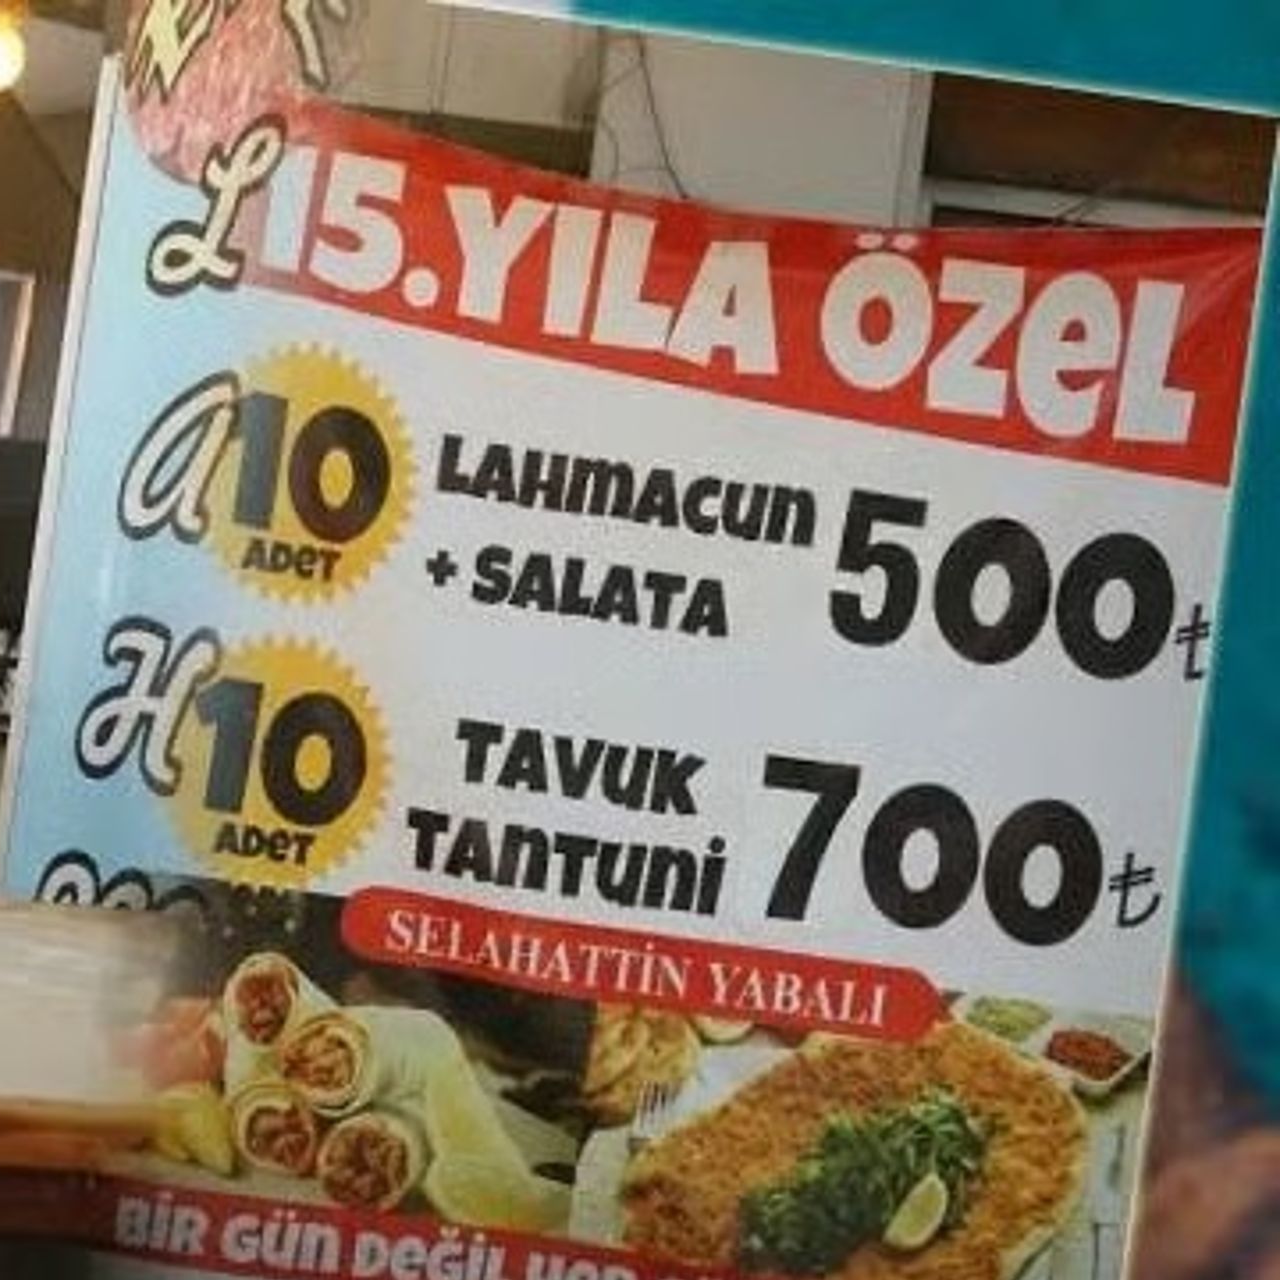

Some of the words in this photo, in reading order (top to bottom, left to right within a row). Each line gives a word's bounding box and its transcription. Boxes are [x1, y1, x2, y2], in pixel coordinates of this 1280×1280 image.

[255, 143, 782, 378] 15.YILA
[819, 233, 1197, 446] ÖZEL
[230, 391, 390, 542] 10
[437, 432, 817, 548] LAHMACUN
[241, 538, 342, 582] ADET
[471, 544, 728, 638] SALATA
[195, 677, 367, 826] 10
[455, 718, 707, 816] TAVUK
[213, 820, 317, 866] ADET
[708, 960, 889, 1028] YABALI
[114, 1193, 210, 1255] BİR
[218, 1210, 342, 1275] GÜN
